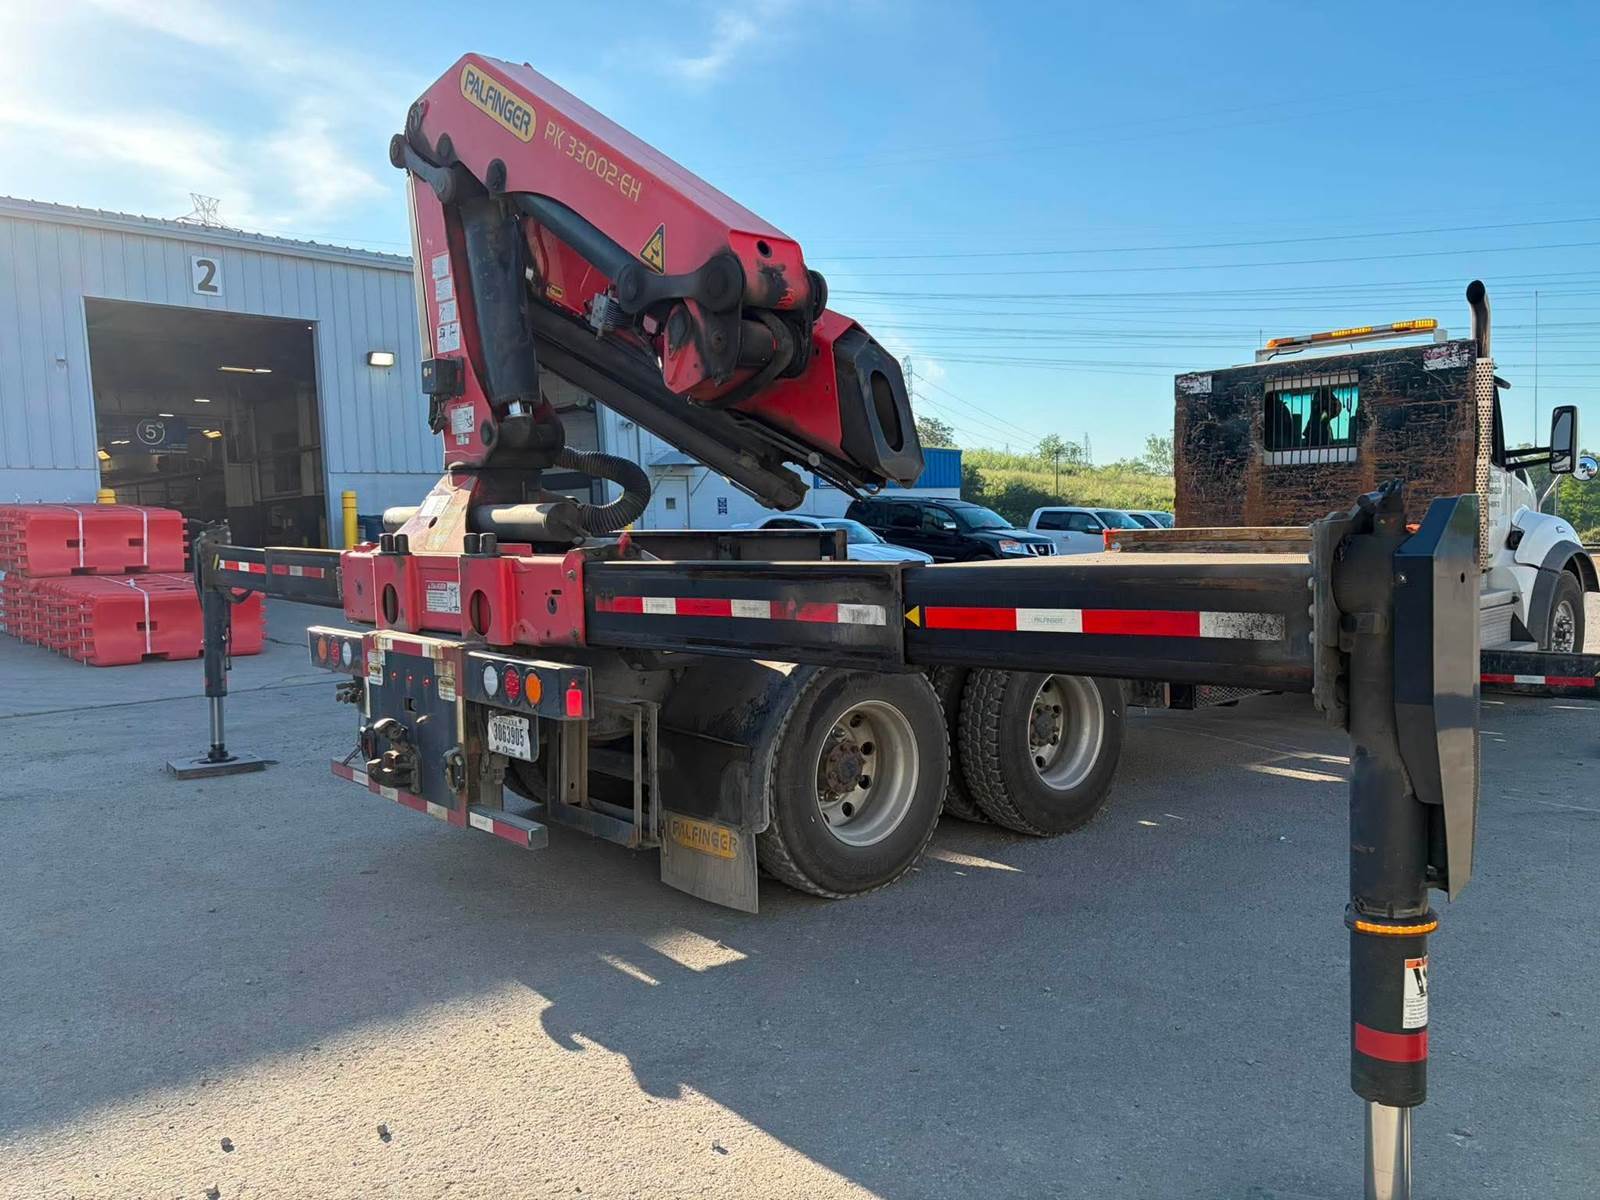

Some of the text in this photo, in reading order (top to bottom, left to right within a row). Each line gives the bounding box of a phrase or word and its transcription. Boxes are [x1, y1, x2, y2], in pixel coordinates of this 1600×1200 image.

[464, 69, 532, 137] PALFINGER
[544, 120, 567, 151] PK
[196, 259, 218, 293] 2
[672, 819, 738, 853] PALFINGER
